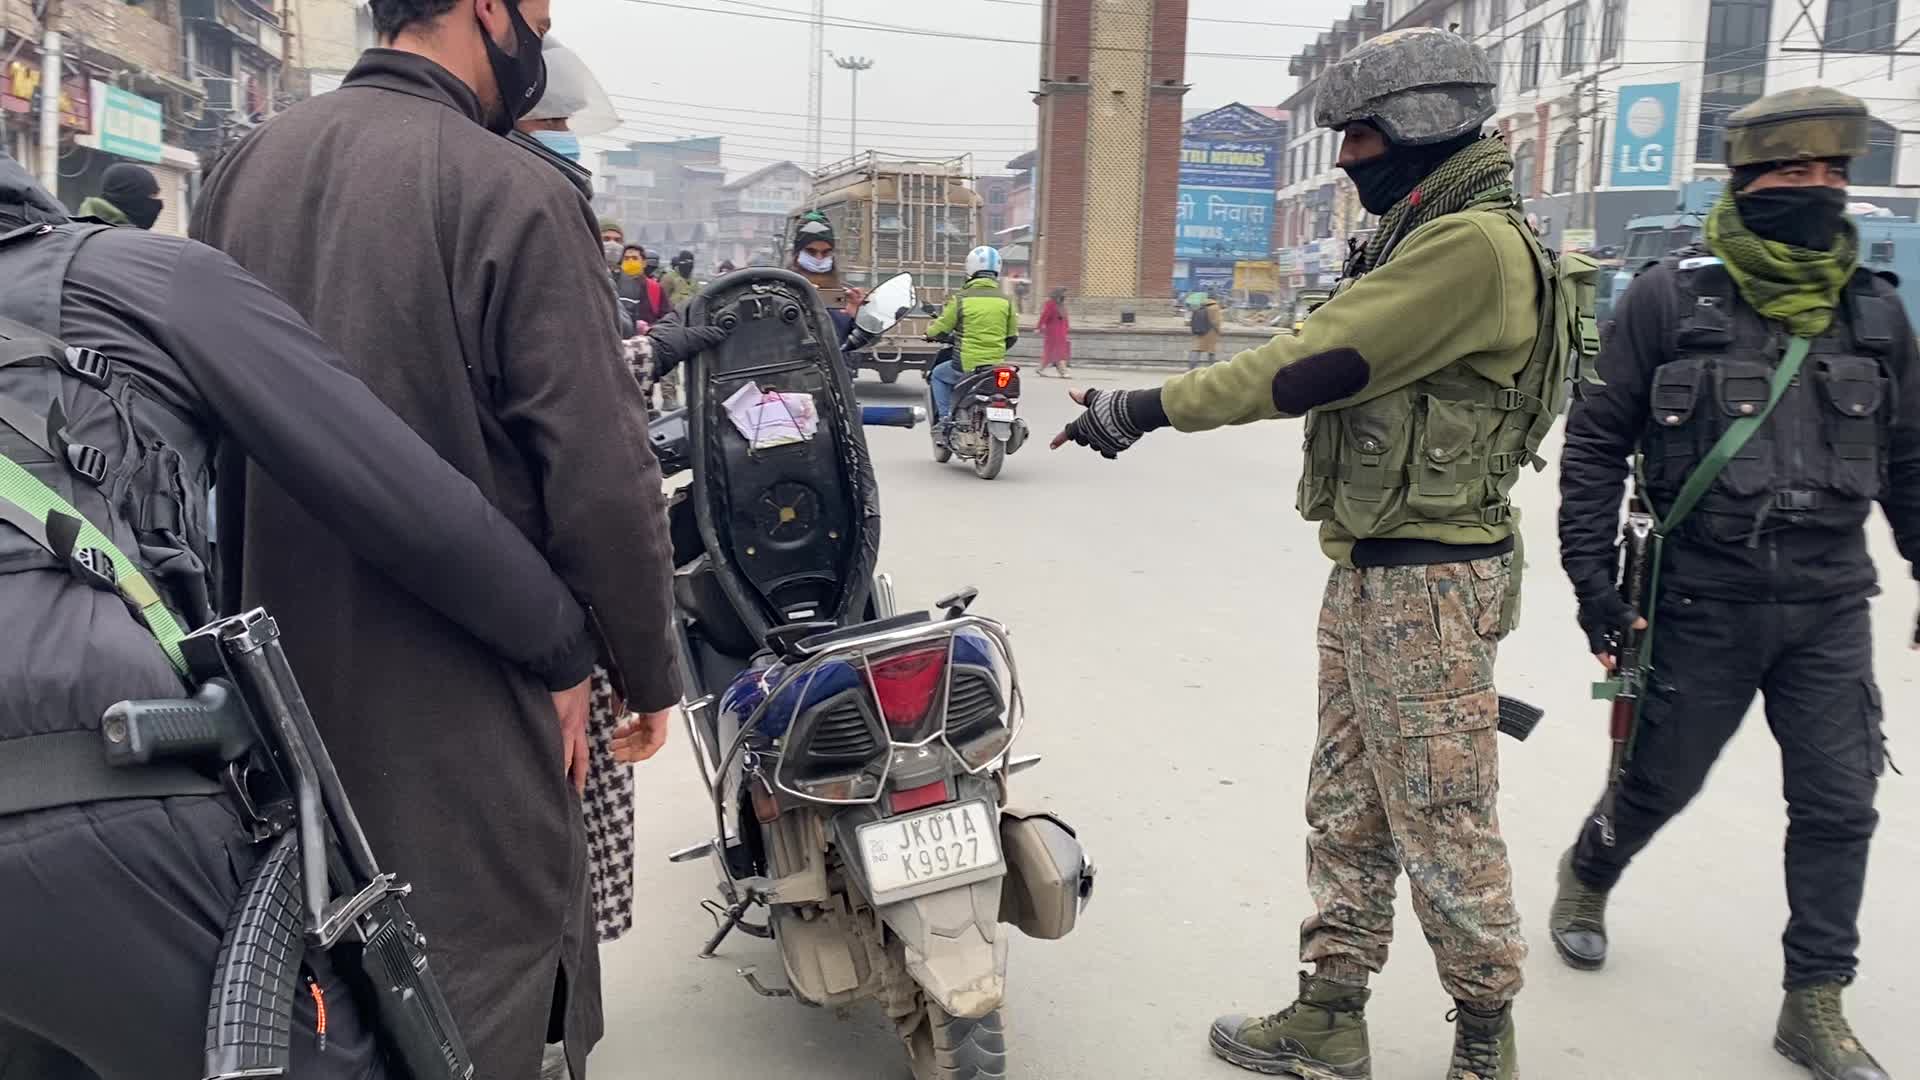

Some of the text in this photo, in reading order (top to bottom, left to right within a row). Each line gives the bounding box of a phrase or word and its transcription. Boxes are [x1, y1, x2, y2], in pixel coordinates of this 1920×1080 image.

[1620, 143, 1665, 173] LG
[1206, 194, 1268, 223] निवास
[899, 808, 977, 850] JK01A
[901, 837, 979, 881] K9927
